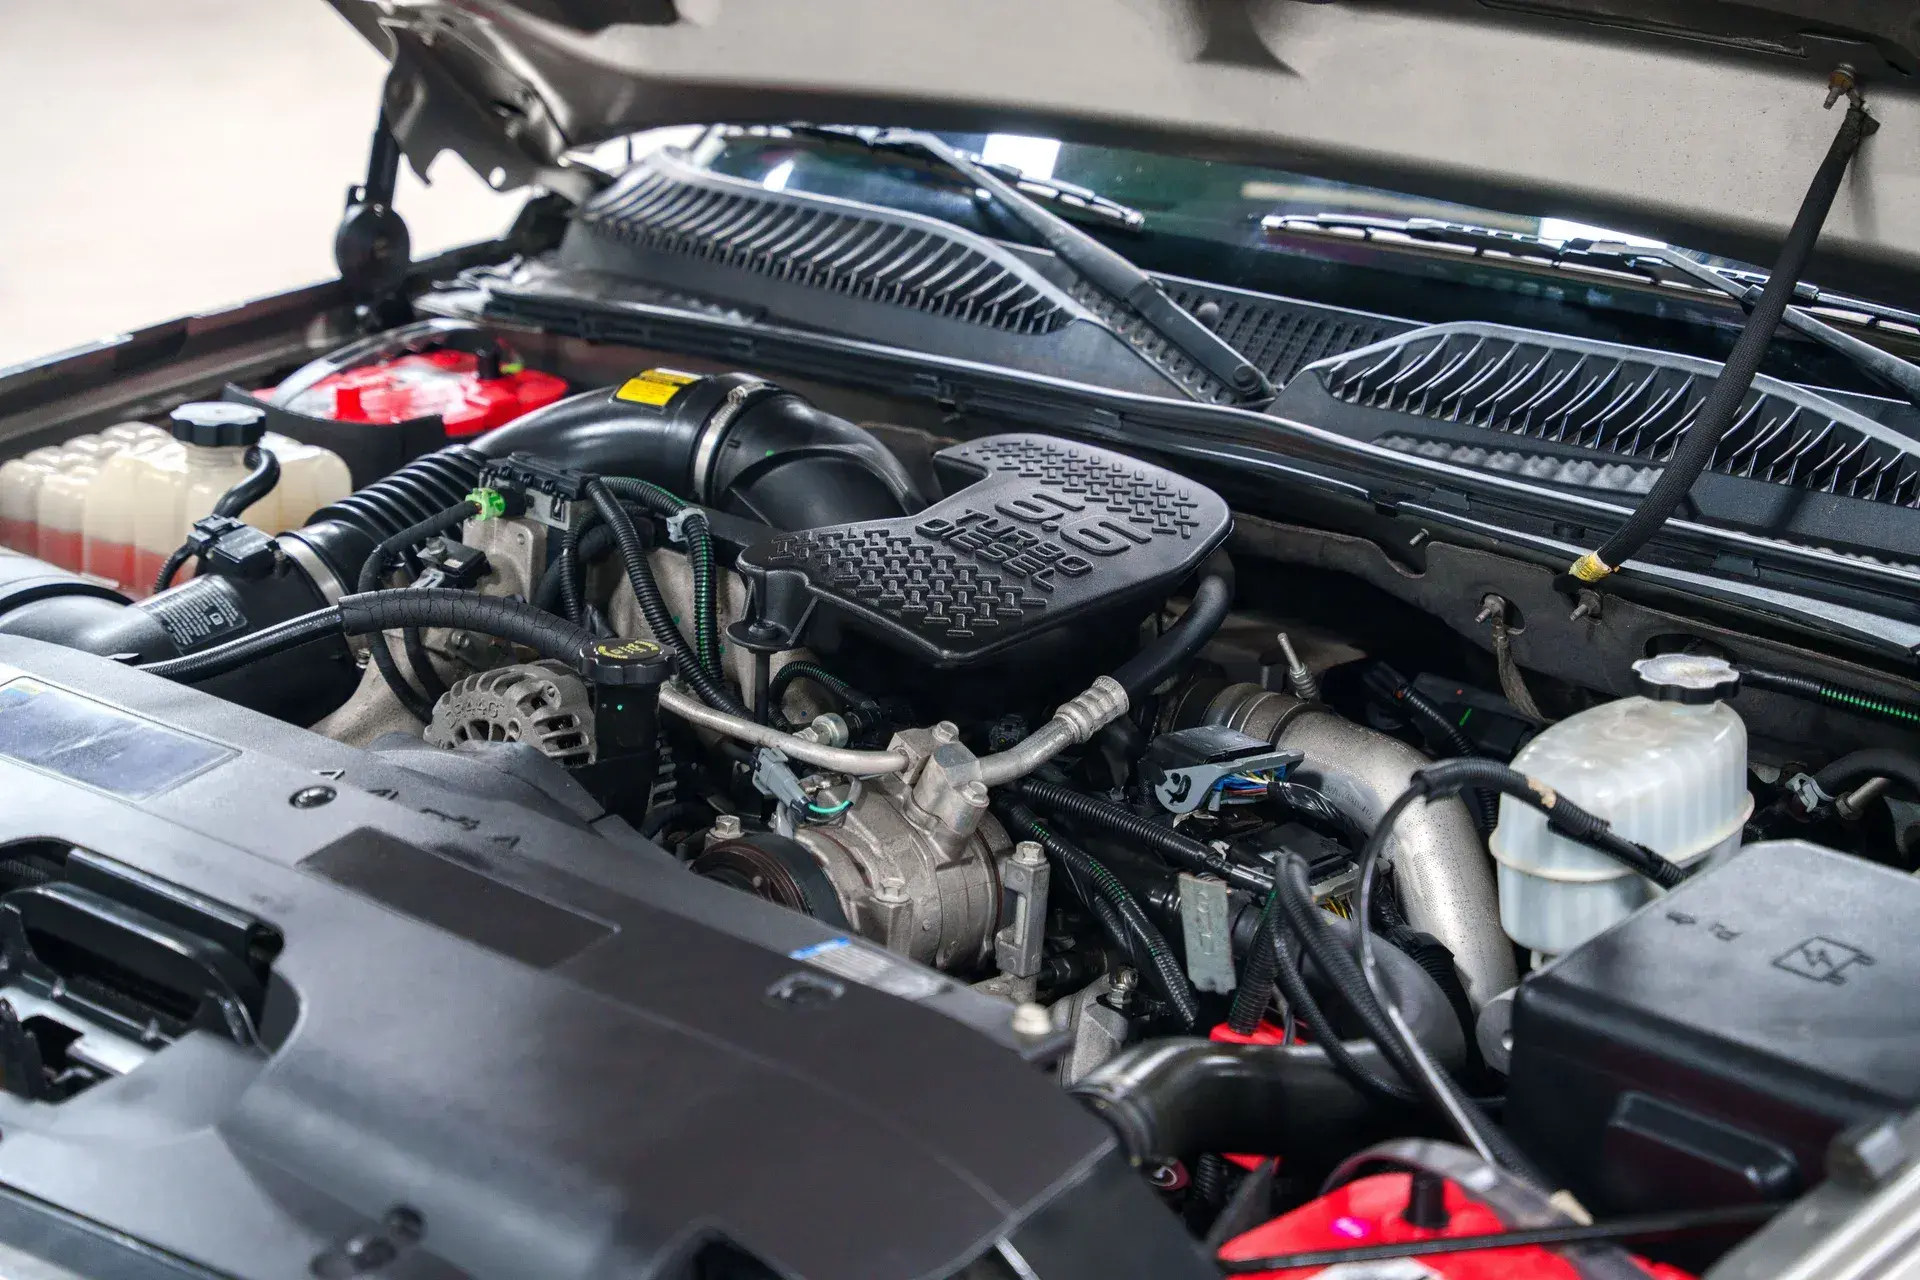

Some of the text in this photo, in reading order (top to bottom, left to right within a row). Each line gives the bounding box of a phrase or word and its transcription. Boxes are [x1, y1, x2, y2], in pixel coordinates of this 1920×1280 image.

[915, 518, 1055, 592] DIESEL
[956, 508, 1094, 577] TURBO
[995, 489, 1152, 556] 6.6
